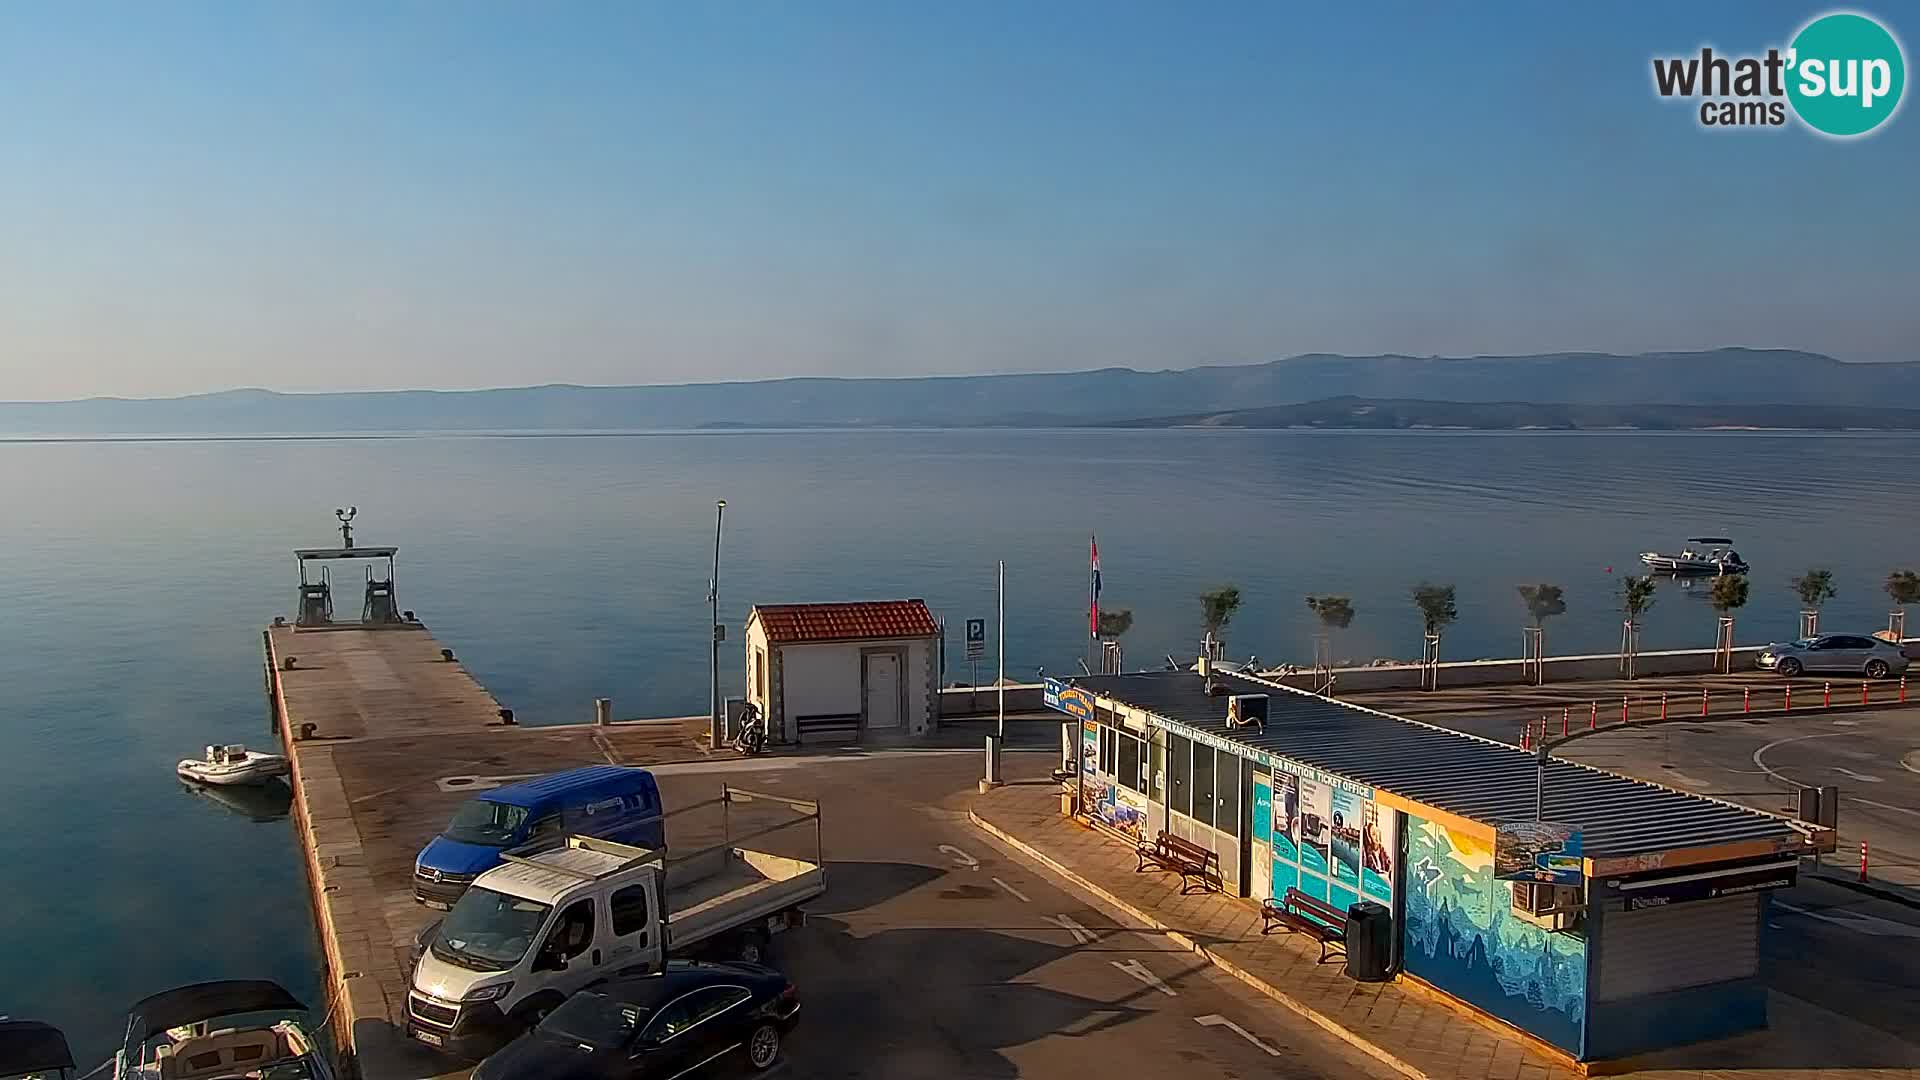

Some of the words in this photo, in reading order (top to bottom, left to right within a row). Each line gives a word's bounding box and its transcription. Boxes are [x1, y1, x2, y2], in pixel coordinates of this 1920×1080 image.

[970, 622, 980, 638] P
[1172, 724, 1193, 739] KARATA
[1193, 730, 1230, 750] AUTOBUSNA
[1230, 742, 1259, 761] POSTAJA
[1269, 756, 1282, 769] BUS
[1284, 760, 1314, 780] STATION
[1317, 769, 1342, 788] TICKET
[1343, 781, 1370, 798] OFFICE
